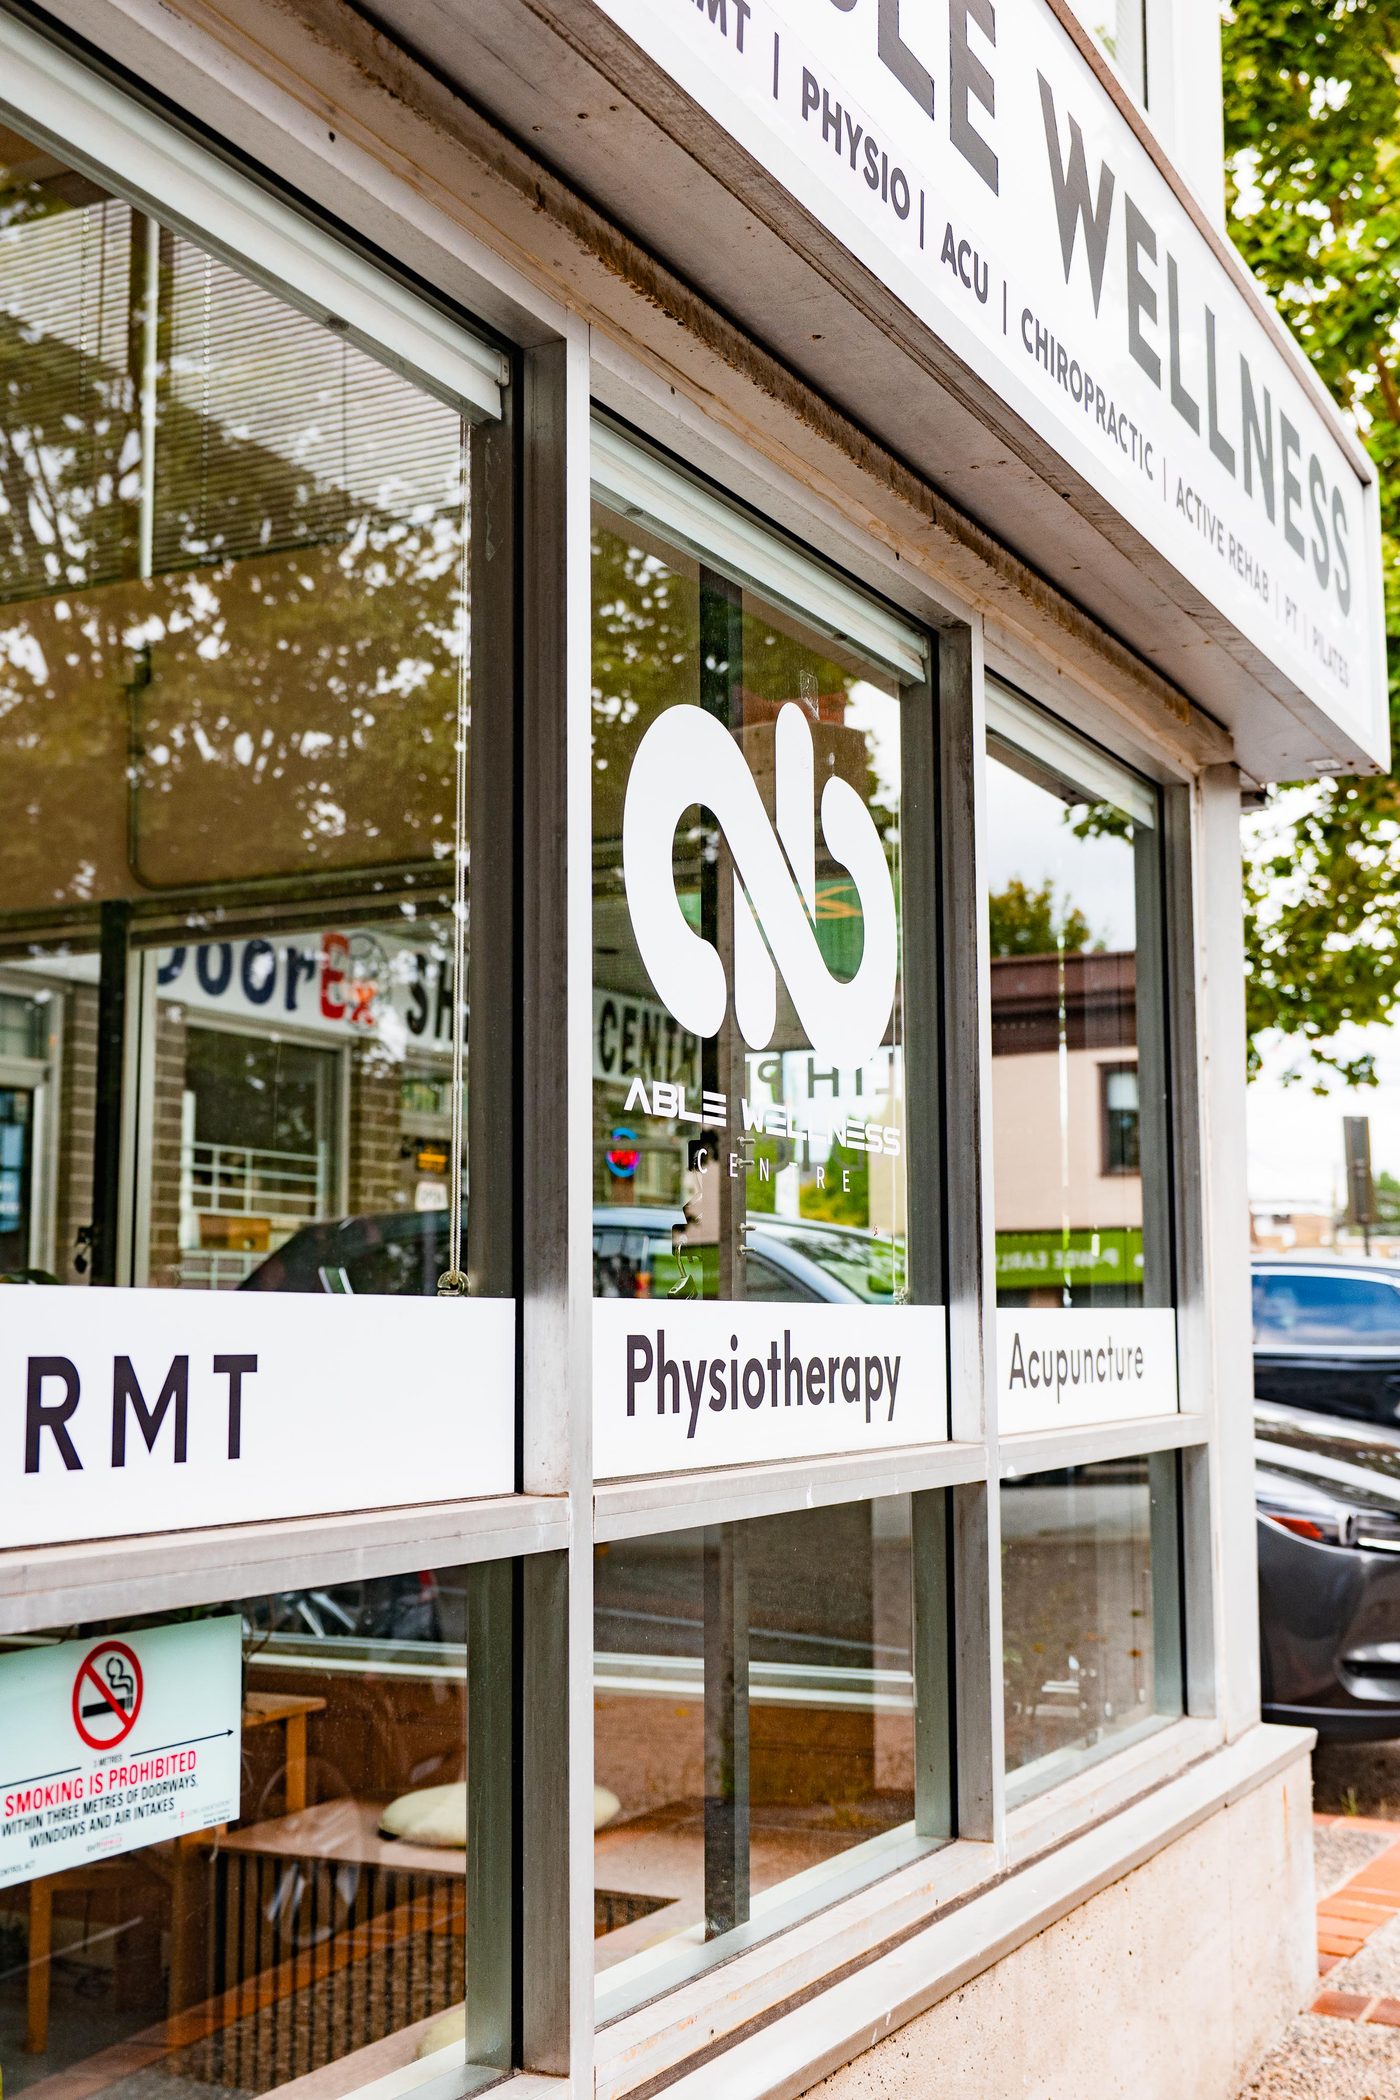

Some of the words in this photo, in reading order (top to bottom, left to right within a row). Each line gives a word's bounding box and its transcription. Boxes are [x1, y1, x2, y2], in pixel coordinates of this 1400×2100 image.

[693, 0, 750, 54] MT
[801, 66, 910, 220] PHYSIO
[941, 222, 988, 304] ACU
[1021, 308, 1154, 481] CHIROPRACTIC
[1176, 477, 1224, 557] ACTIVE
[1229, 532, 1269, 604] REHAB
[1285, 595, 1297, 633] PT
[1036, 68, 1350, 618] WELLNESS
[624, 1077, 727, 1128] ABLE
[741, 1098, 901, 1156] WELLNESS
[626, 1329, 901, 1439] Physiotherapy
[1009, 1333, 1144, 1404] Acupuncture
[25, 1354, 258, 1474] RMT
[1, 1814, 43, 1837] WITHIN
[47, 1804, 79, 1824] THREE
[82, 1792, 123, 1815] METRES
[126, 1788, 139, 1804] OF
[5, 1777, 84, 1818] SMOKING
[89, 1772, 104, 1795] IS
[109, 1750, 197, 1790] PROHIBITED
[29, 1821, 85, 1849] WINDOWS
[89, 1814, 111, 1833] AND
[114, 1807, 132, 1826] AIR
[133, 1797, 175, 1819] INTAKES
